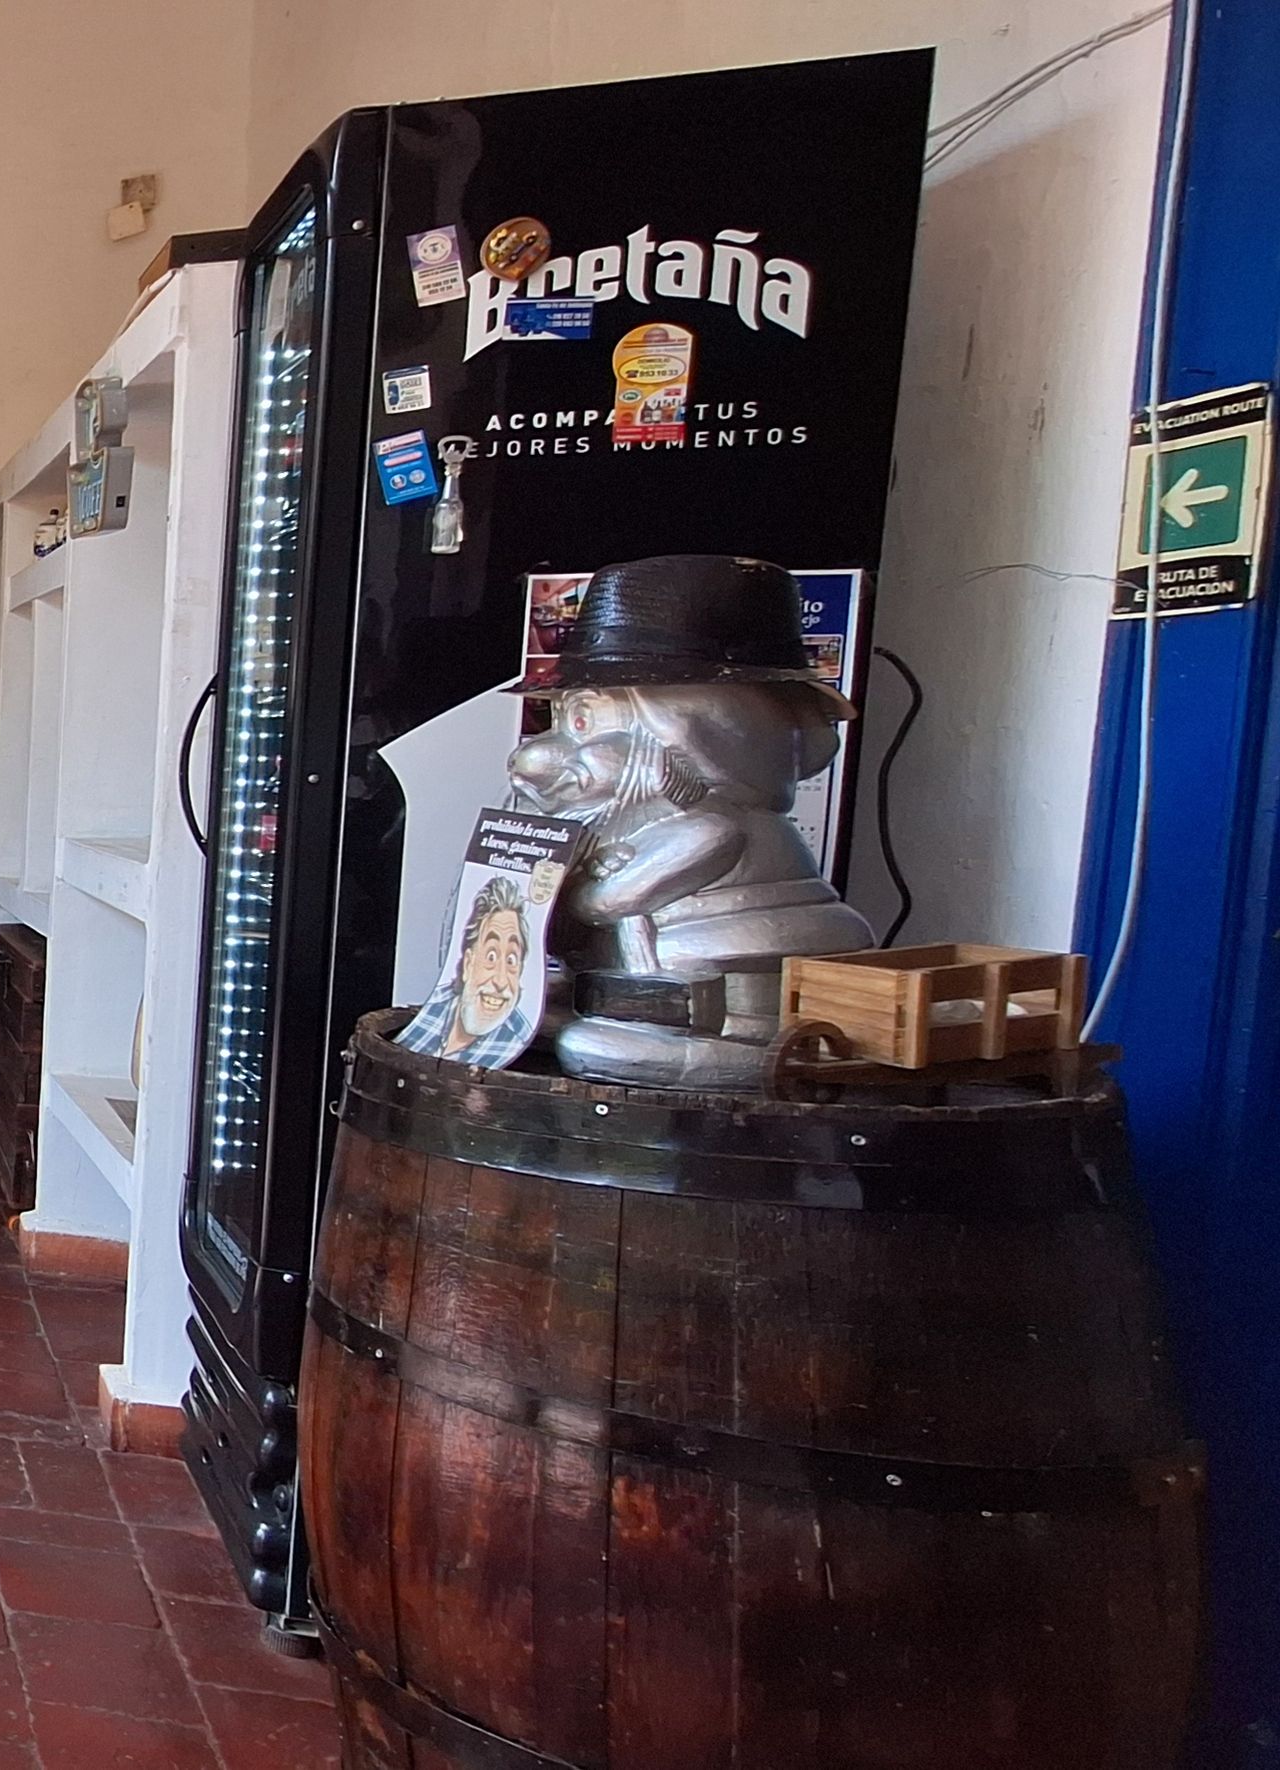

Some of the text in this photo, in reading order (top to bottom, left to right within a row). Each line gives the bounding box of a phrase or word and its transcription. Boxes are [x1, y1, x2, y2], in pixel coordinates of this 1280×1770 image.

[694, 401, 759, 422] TUS
[1132, 397, 1266, 435] EVACUATION ROUTE
[1157, 565, 1220, 584] RUTA DE
[1133, 580, 1235, 603] EACUACION
[532, 827, 570, 843] entrada
